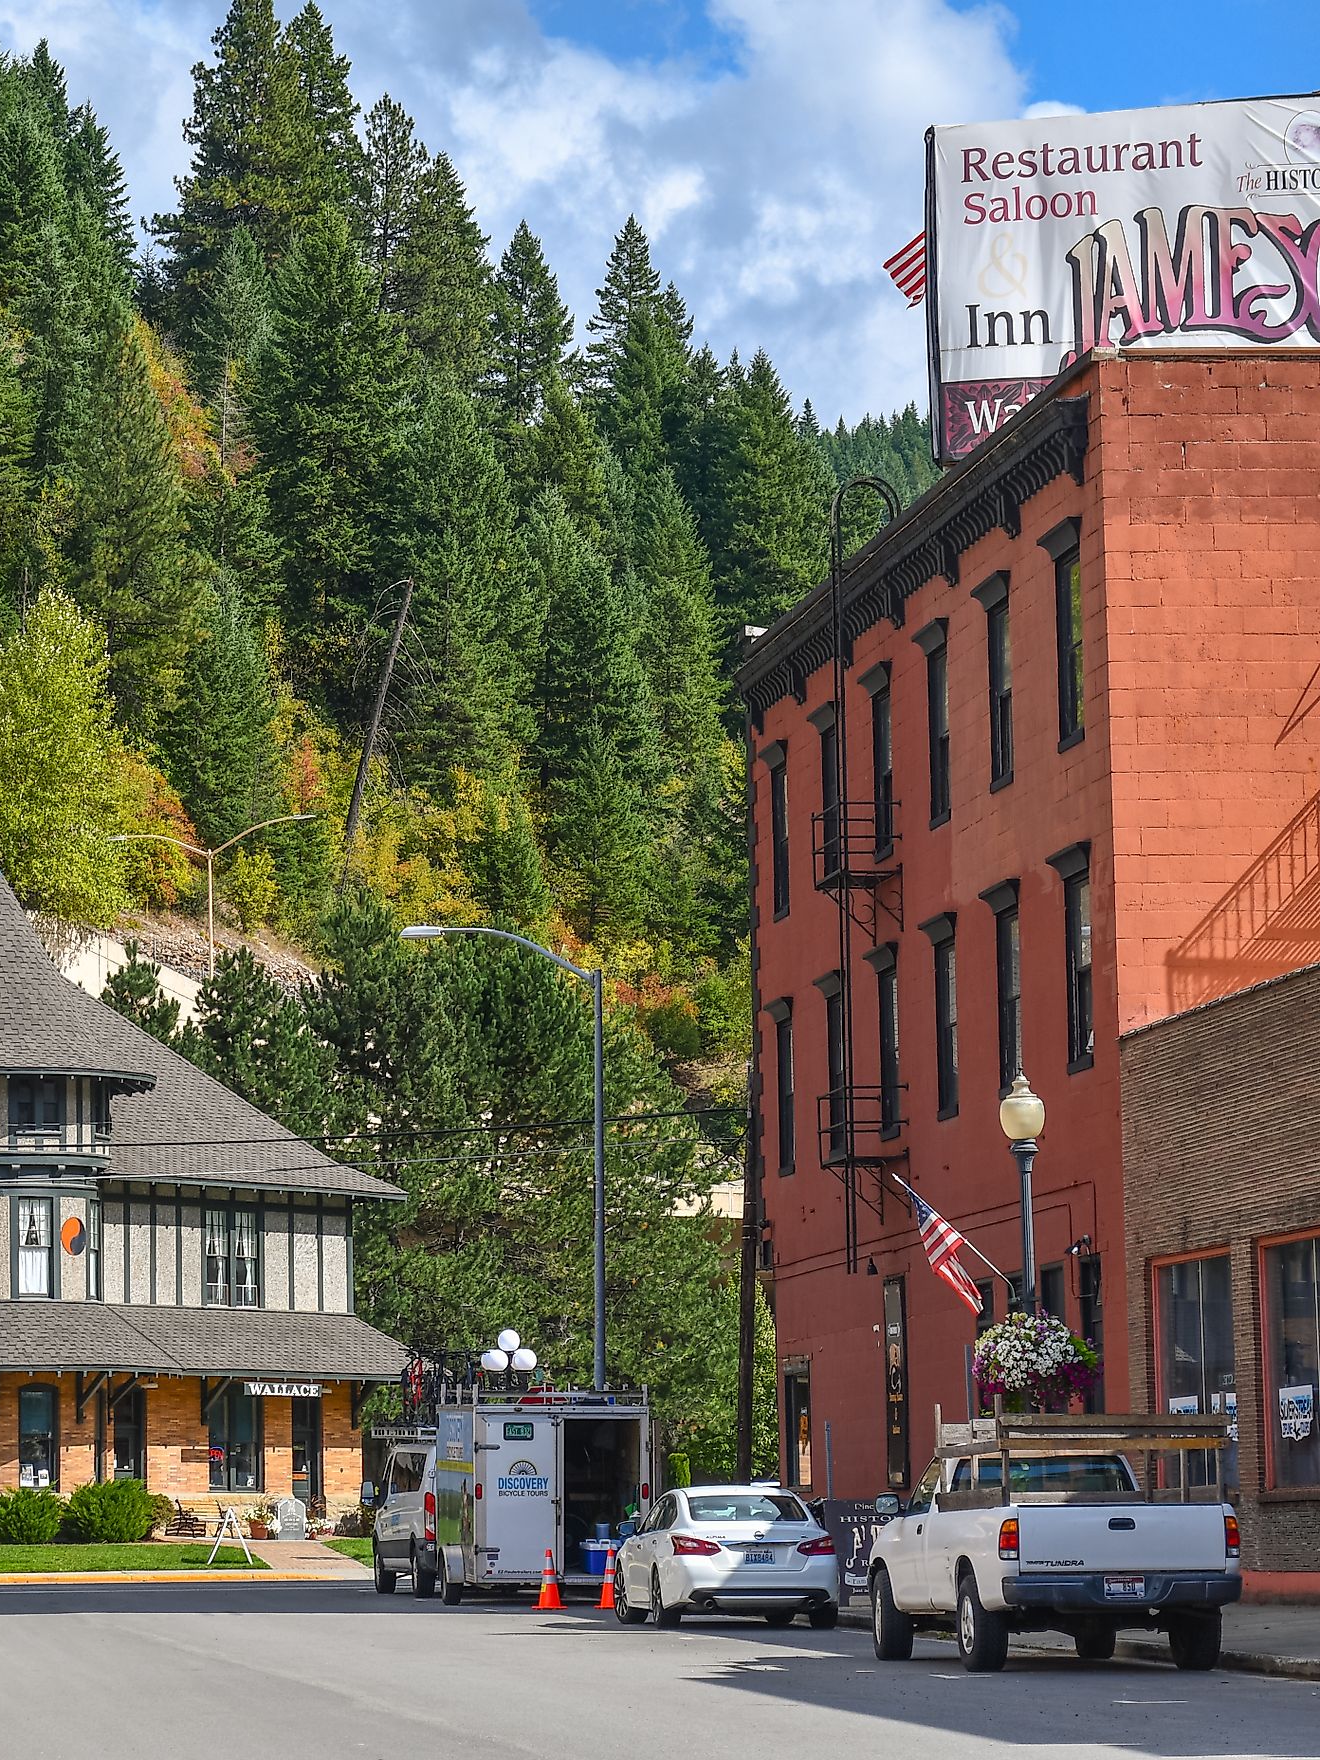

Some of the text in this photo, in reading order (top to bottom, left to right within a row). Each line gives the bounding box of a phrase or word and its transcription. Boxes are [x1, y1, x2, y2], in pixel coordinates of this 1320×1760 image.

[960, 132, 1203, 184] Restaurant
[1237, 172, 1262, 193] The
[963, 185, 1099, 226] Saloon
[964, 303, 1054, 349] Inn
[248, 1383, 320, 1397] WALLACE
[498, 1477, 549, 1490] DISCOVERY
